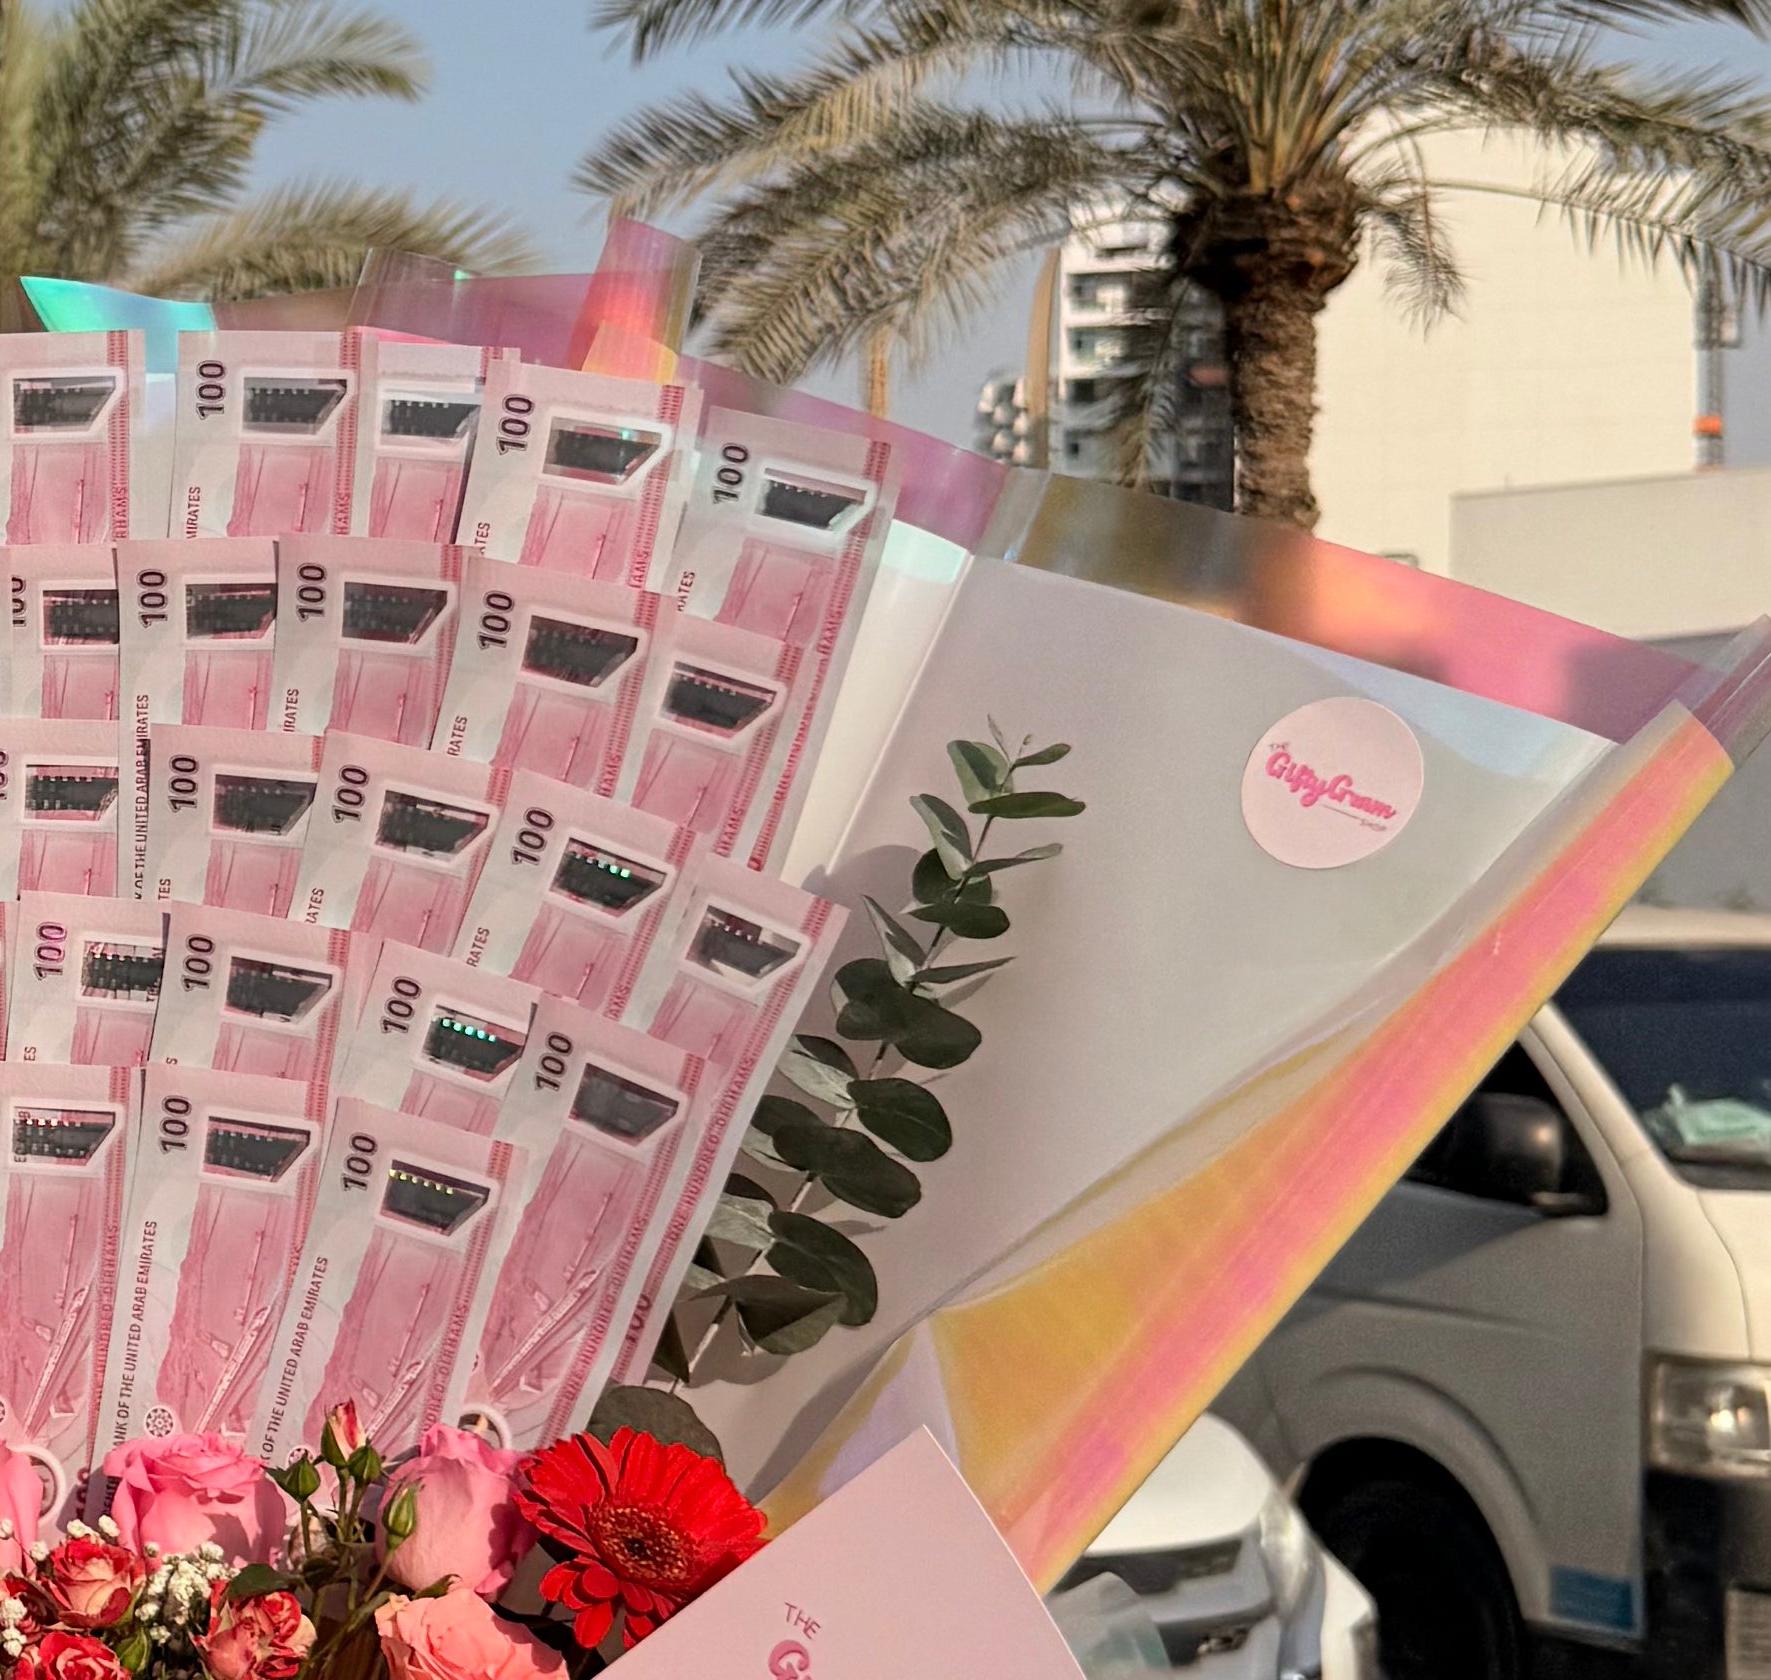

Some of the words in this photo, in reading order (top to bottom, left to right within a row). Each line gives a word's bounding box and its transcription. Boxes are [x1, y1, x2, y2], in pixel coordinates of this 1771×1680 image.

[196, 359, 226, 420] 100
[496, 394, 533, 455] 100
[712, 443, 749, 505] 100
[113, 486, 127, 538] RHAMS
[336, 493, 350, 534] HAMS
[136, 568, 169, 629] 100
[296, 562, 328, 622] 100
[477, 590, 514, 650] 100
[135, 694, 149, 755] EMIRATES
[280, 687, 302, 732] IRATES
[443, 714, 471, 757] RATES
[134, 760, 148, 792] ARAB
[168, 755, 200, 814] 100
[332, 765, 369, 823] 100
[600, 752, 621, 798] HAMS
[134, 796, 148, 841] UNITED
[511, 806, 555, 868] 100
[134, 845, 146, 868] THE
[33, 920, 67, 981] 100
[181, 934, 215, 993] 100
[465, 925, 490, 967] RATES
[380, 976, 422, 1036] 100
[535, 1031, 572, 1092] 100
[159, 1094, 192, 1155] 100
[340, 1132, 378, 1193] 100
[136, 1220, 157, 1284] EMIRATES
[131, 1286, 147, 1320] ARAB
[300, 1255, 329, 1320] EMIRATES
[124, 1323, 142, 1371] UNITED
[289, 1321, 309, 1357] ARAB
[117, 1400, 130, 1418] OF
[119, 1374, 134, 1398] THE
[274, 1357, 299, 1406] UNITED
[261, 1434, 277, 1453] OF
[266, 1406, 284, 1433] THE
[784, 1602, 821, 1640] THE
